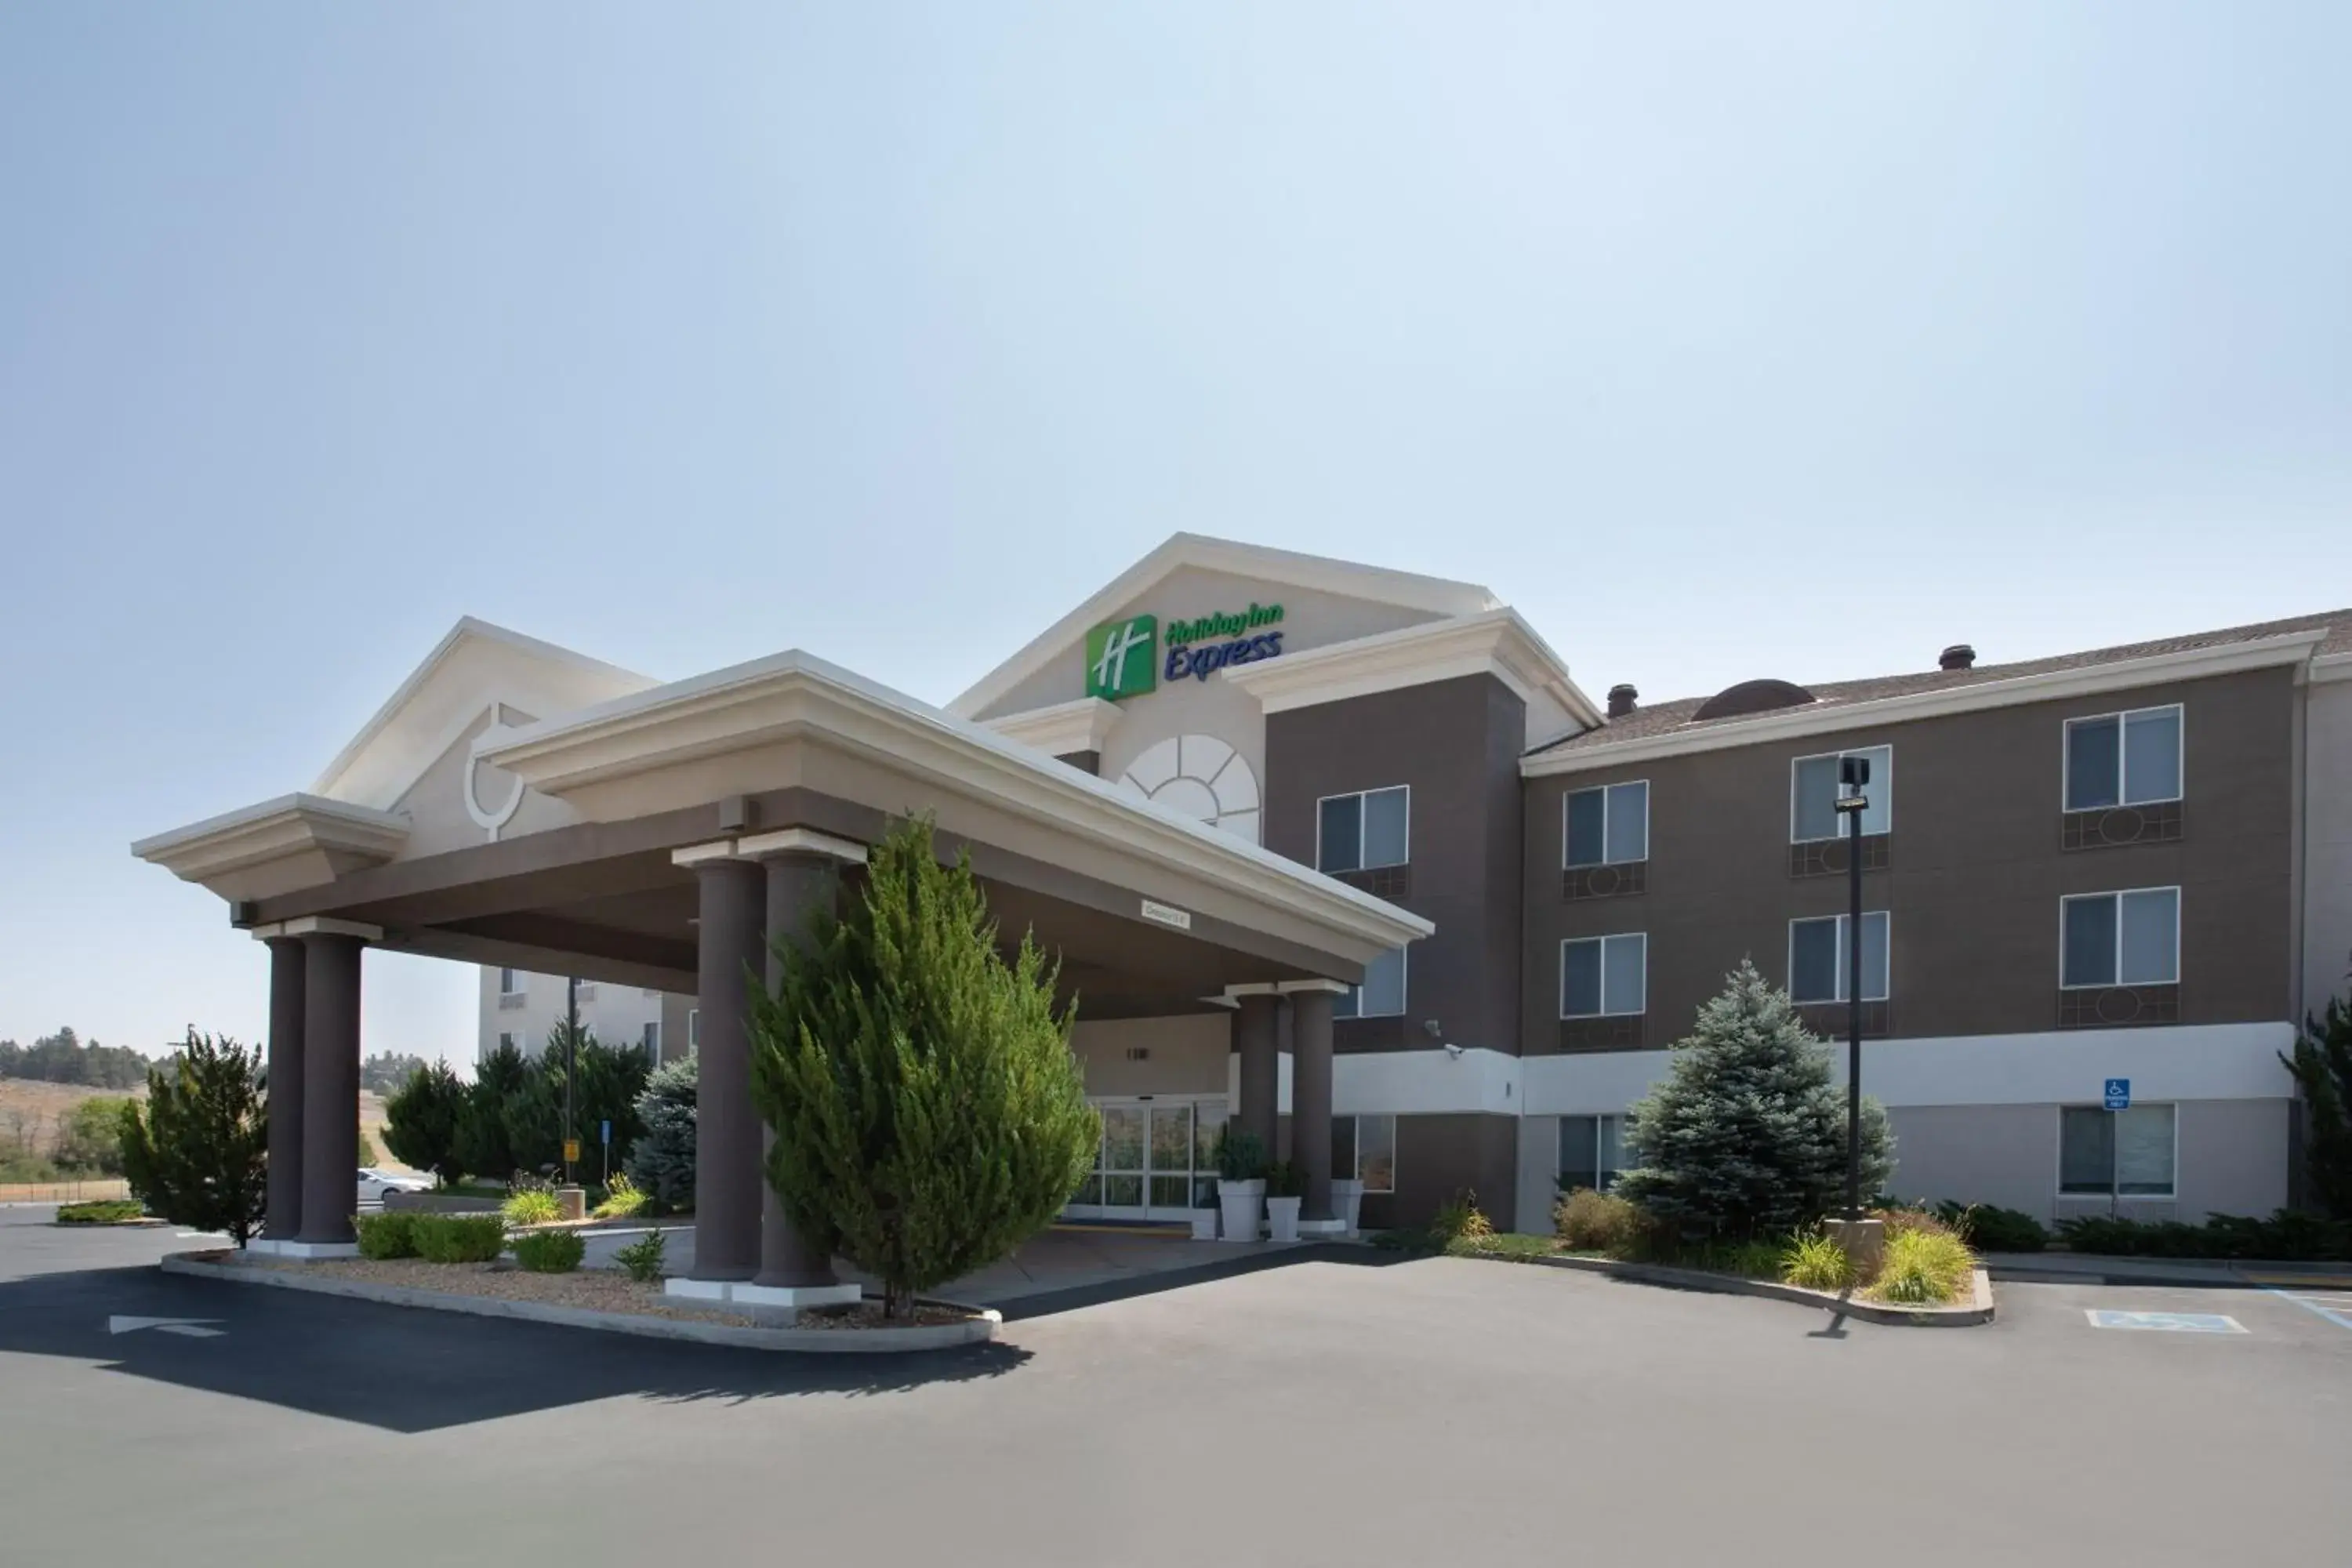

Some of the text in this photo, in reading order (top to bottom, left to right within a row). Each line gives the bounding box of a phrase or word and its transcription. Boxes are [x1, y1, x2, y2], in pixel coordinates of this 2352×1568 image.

[1164, 602, 1285, 646] Holiday Inn
[1164, 630, 1283, 682] Express
